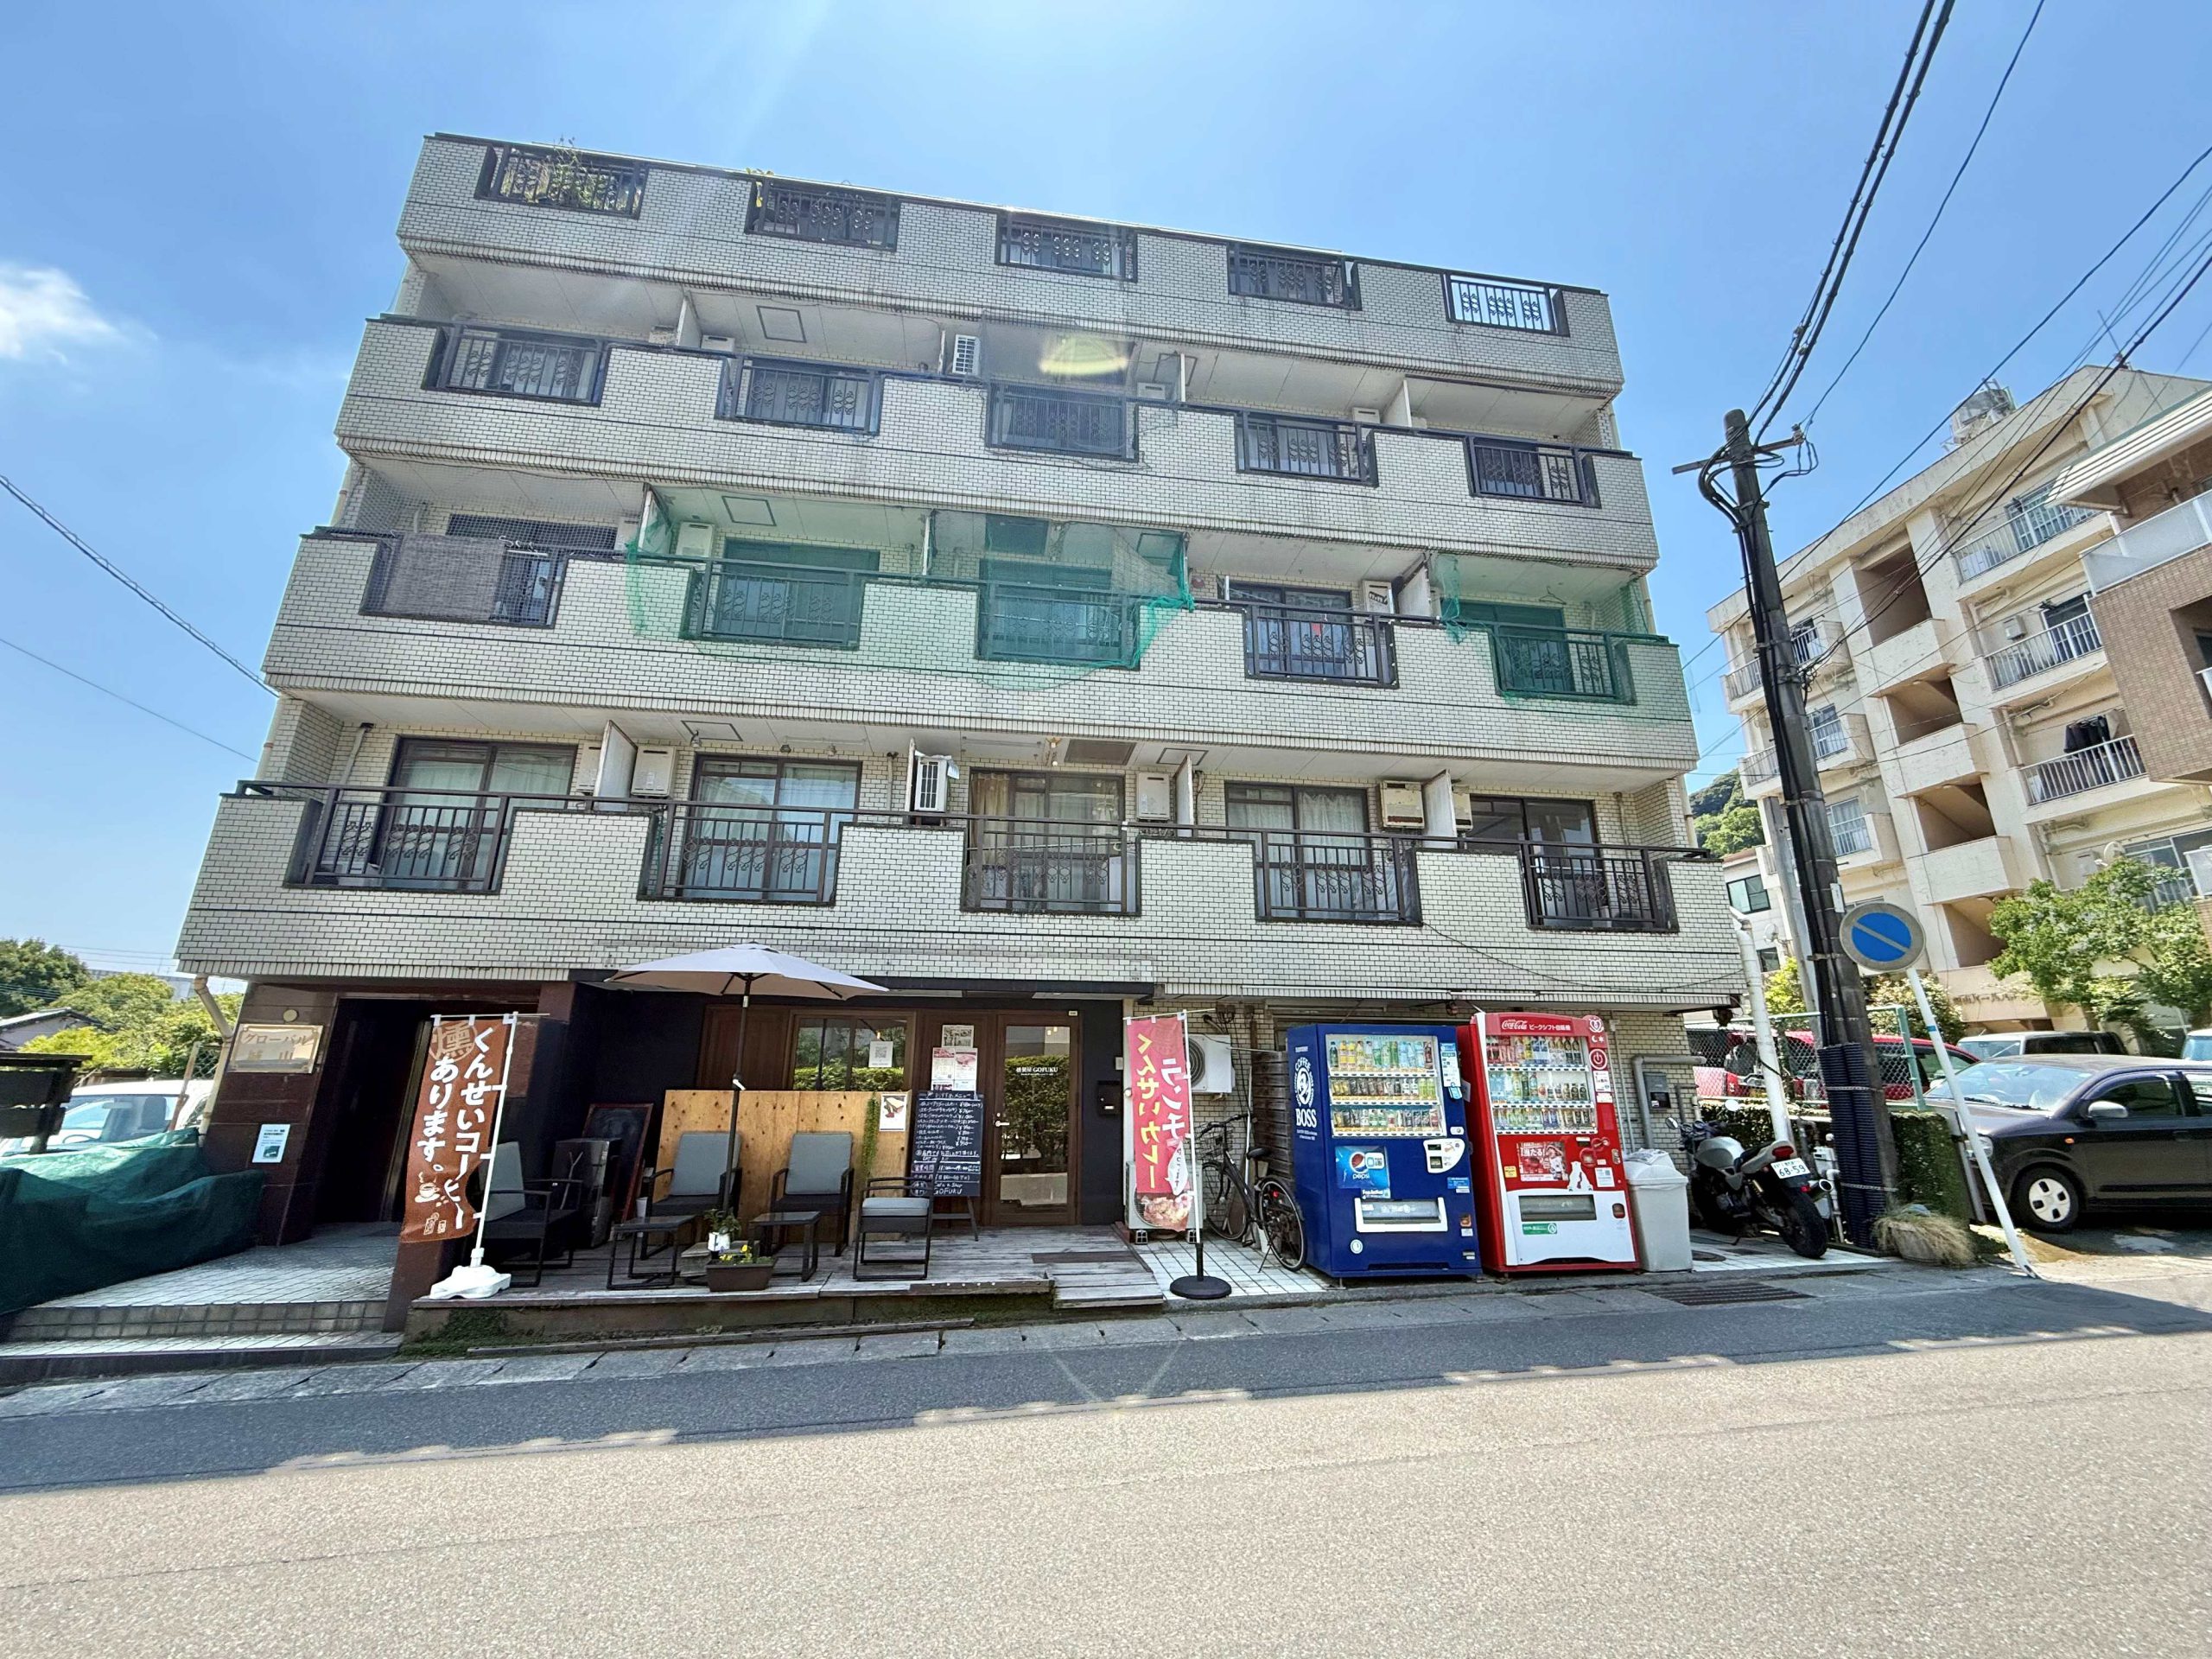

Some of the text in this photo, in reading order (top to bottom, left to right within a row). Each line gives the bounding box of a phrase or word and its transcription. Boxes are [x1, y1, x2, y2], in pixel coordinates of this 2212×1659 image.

[417, 1057, 459, 1172] あります。
[443, 1027, 493, 1229] くんせいコーヒー
[1295, 1108, 1317, 1128] BOSS
[1779, 1165, 1806, 1176] 68-59
